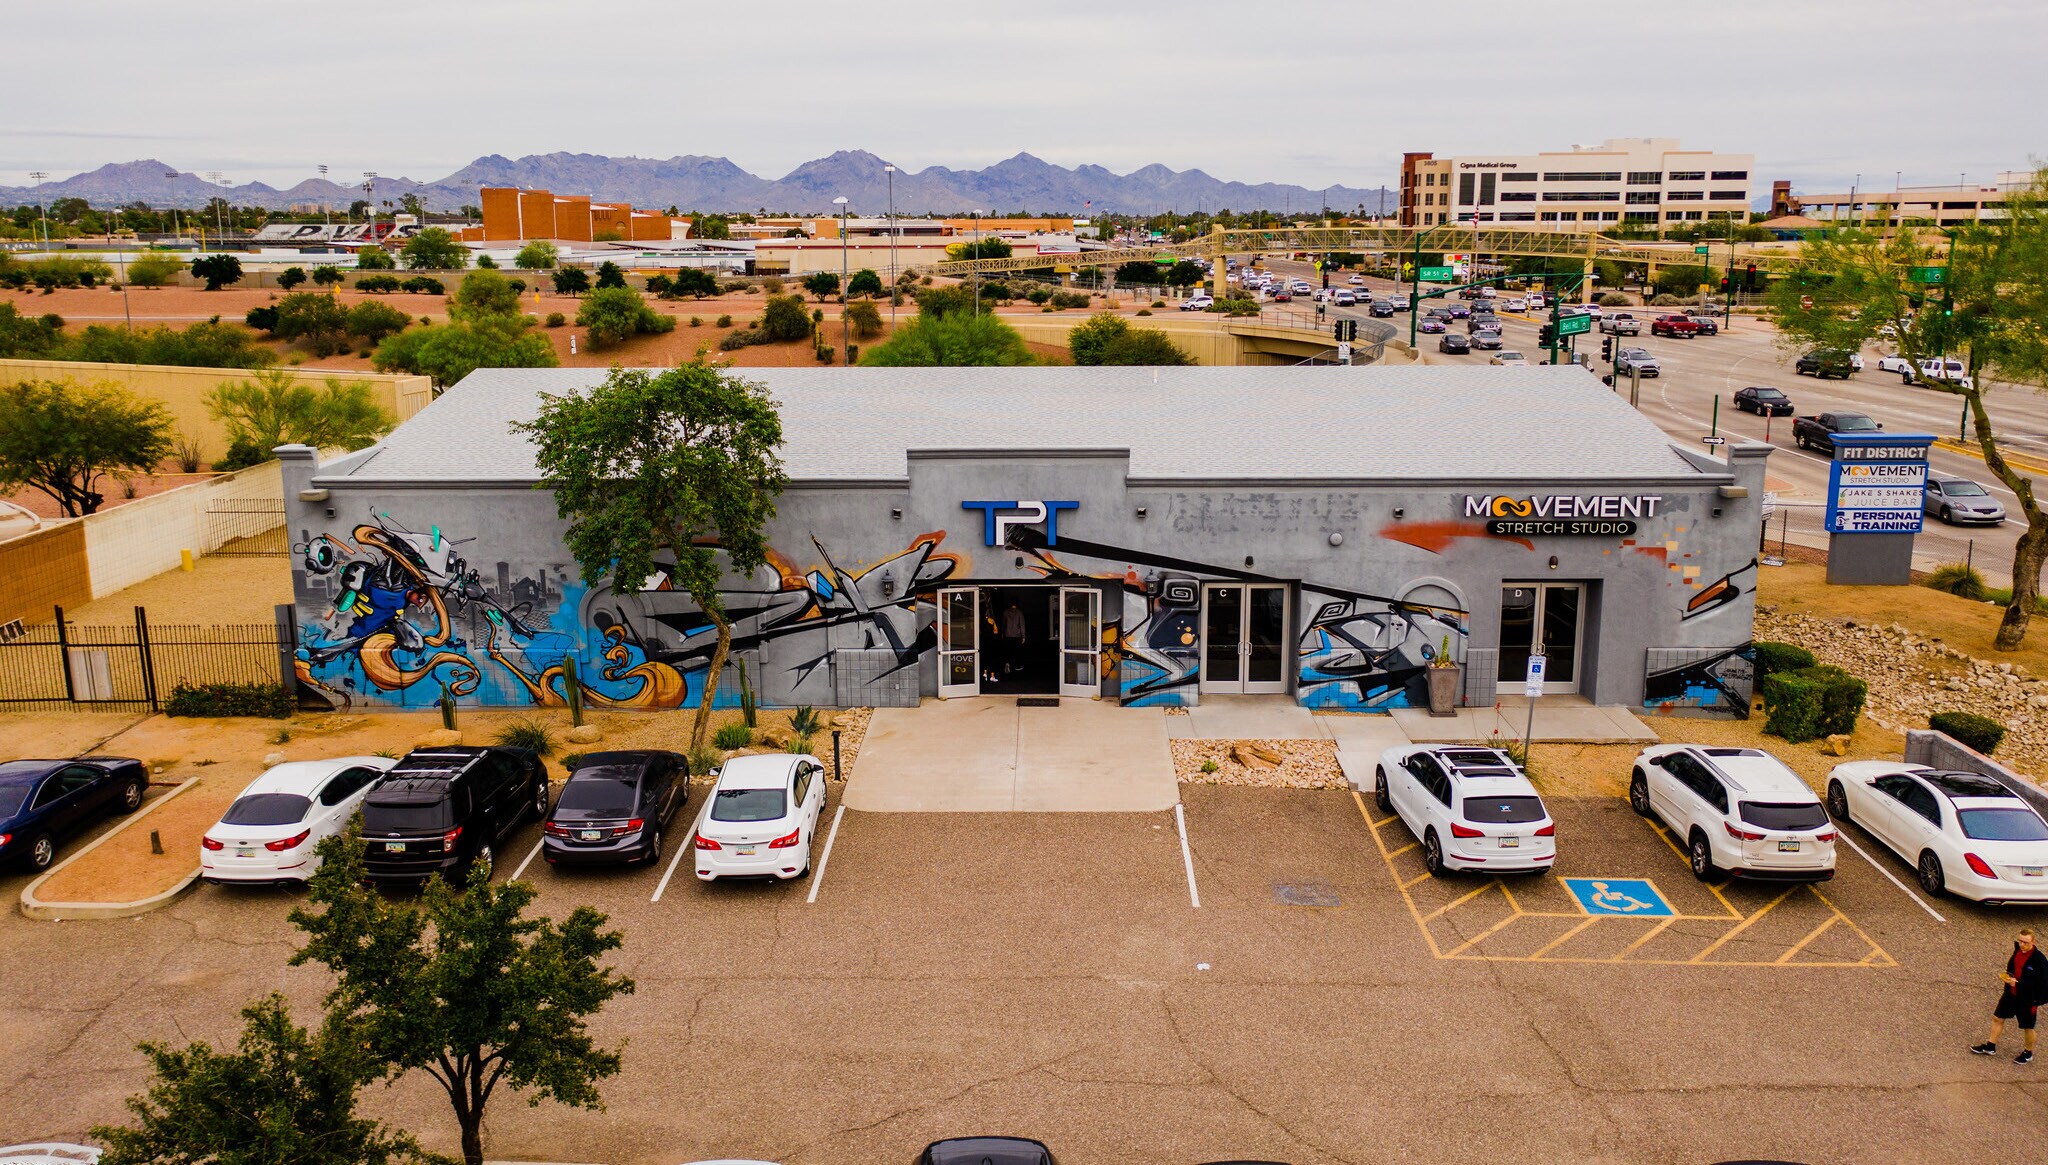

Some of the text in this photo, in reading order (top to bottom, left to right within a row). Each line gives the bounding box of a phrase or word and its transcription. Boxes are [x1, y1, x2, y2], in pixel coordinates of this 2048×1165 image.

[1844, 448, 1926, 458] FIT DISTRICT
[1853, 512, 1920, 520] PERSONAL
[962, 500, 1080, 546] TPT
[1852, 522, 1920, 530] TRAINING
[1496, 522, 1628, 534] STRETCH STUDIO
[1220, 589, 1227, 597] C
[1515, 589, 1522, 597] D
